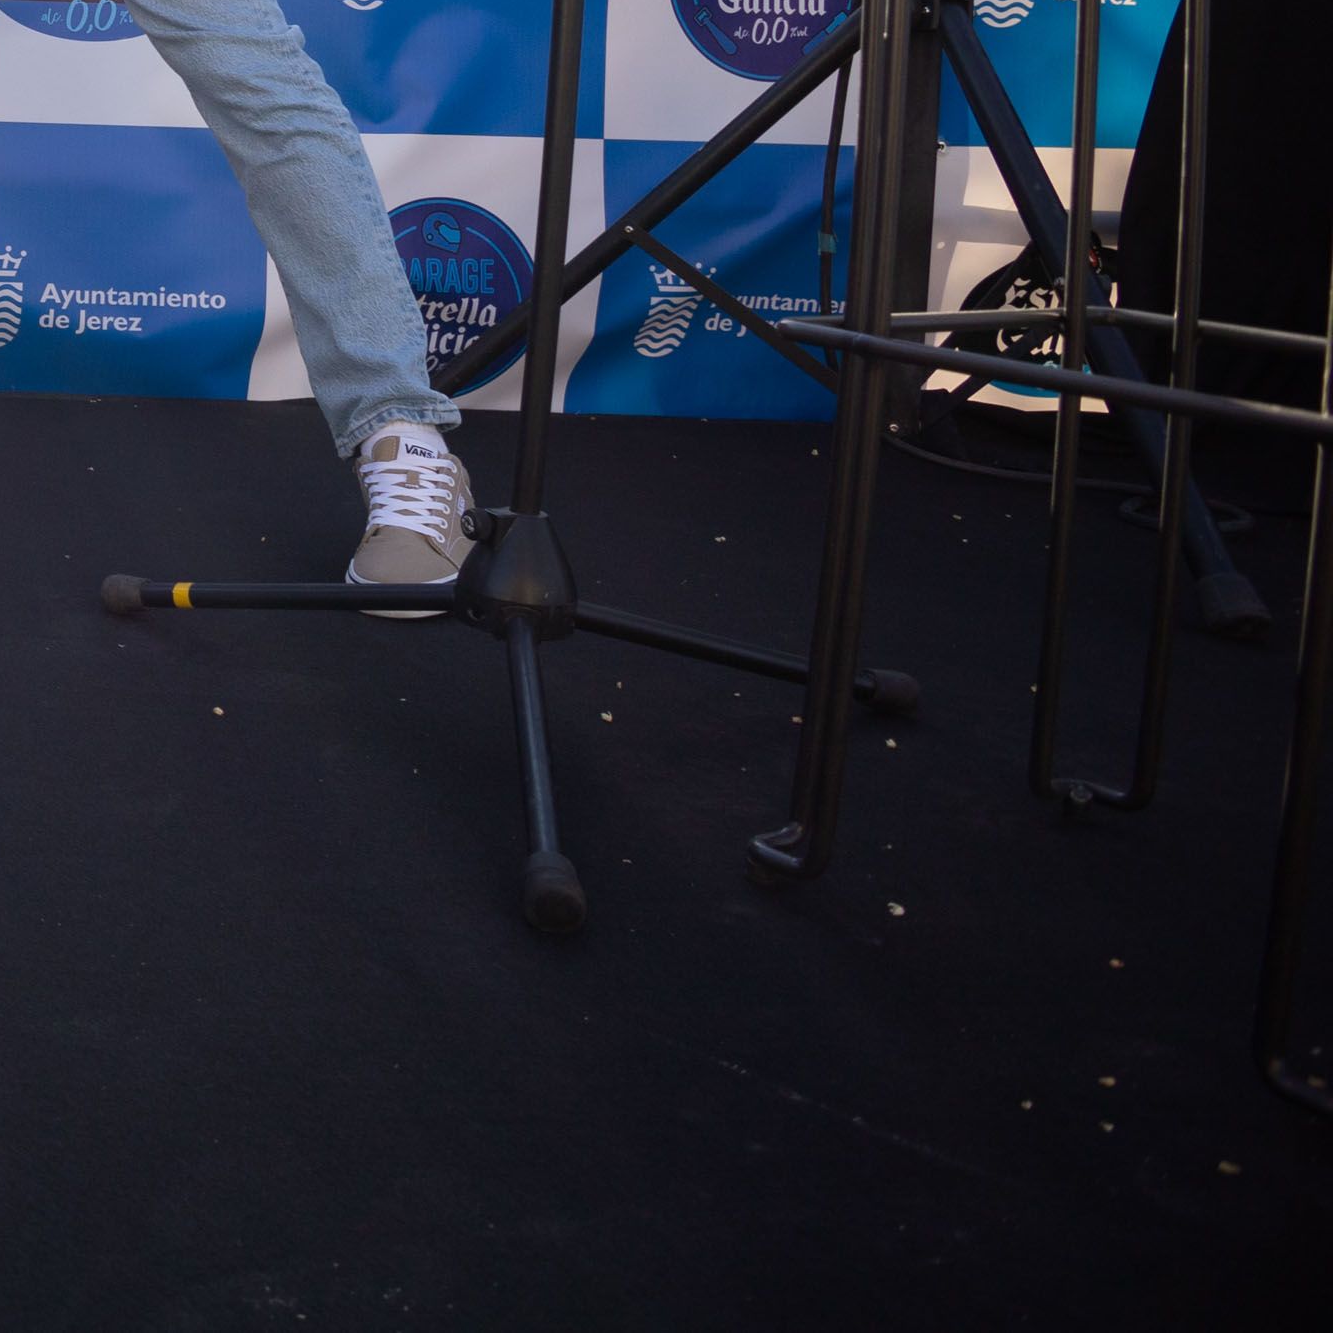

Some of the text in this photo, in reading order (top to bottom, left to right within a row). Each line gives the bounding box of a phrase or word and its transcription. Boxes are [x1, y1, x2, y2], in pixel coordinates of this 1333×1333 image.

[751, 16, 790, 46] 0,0
[403, 257, 495, 295] ARAGE
[39, 282, 227, 310] Ayuntamiento
[38, 308, 143, 335] de Jerez
[704, 312, 733, 332] de
